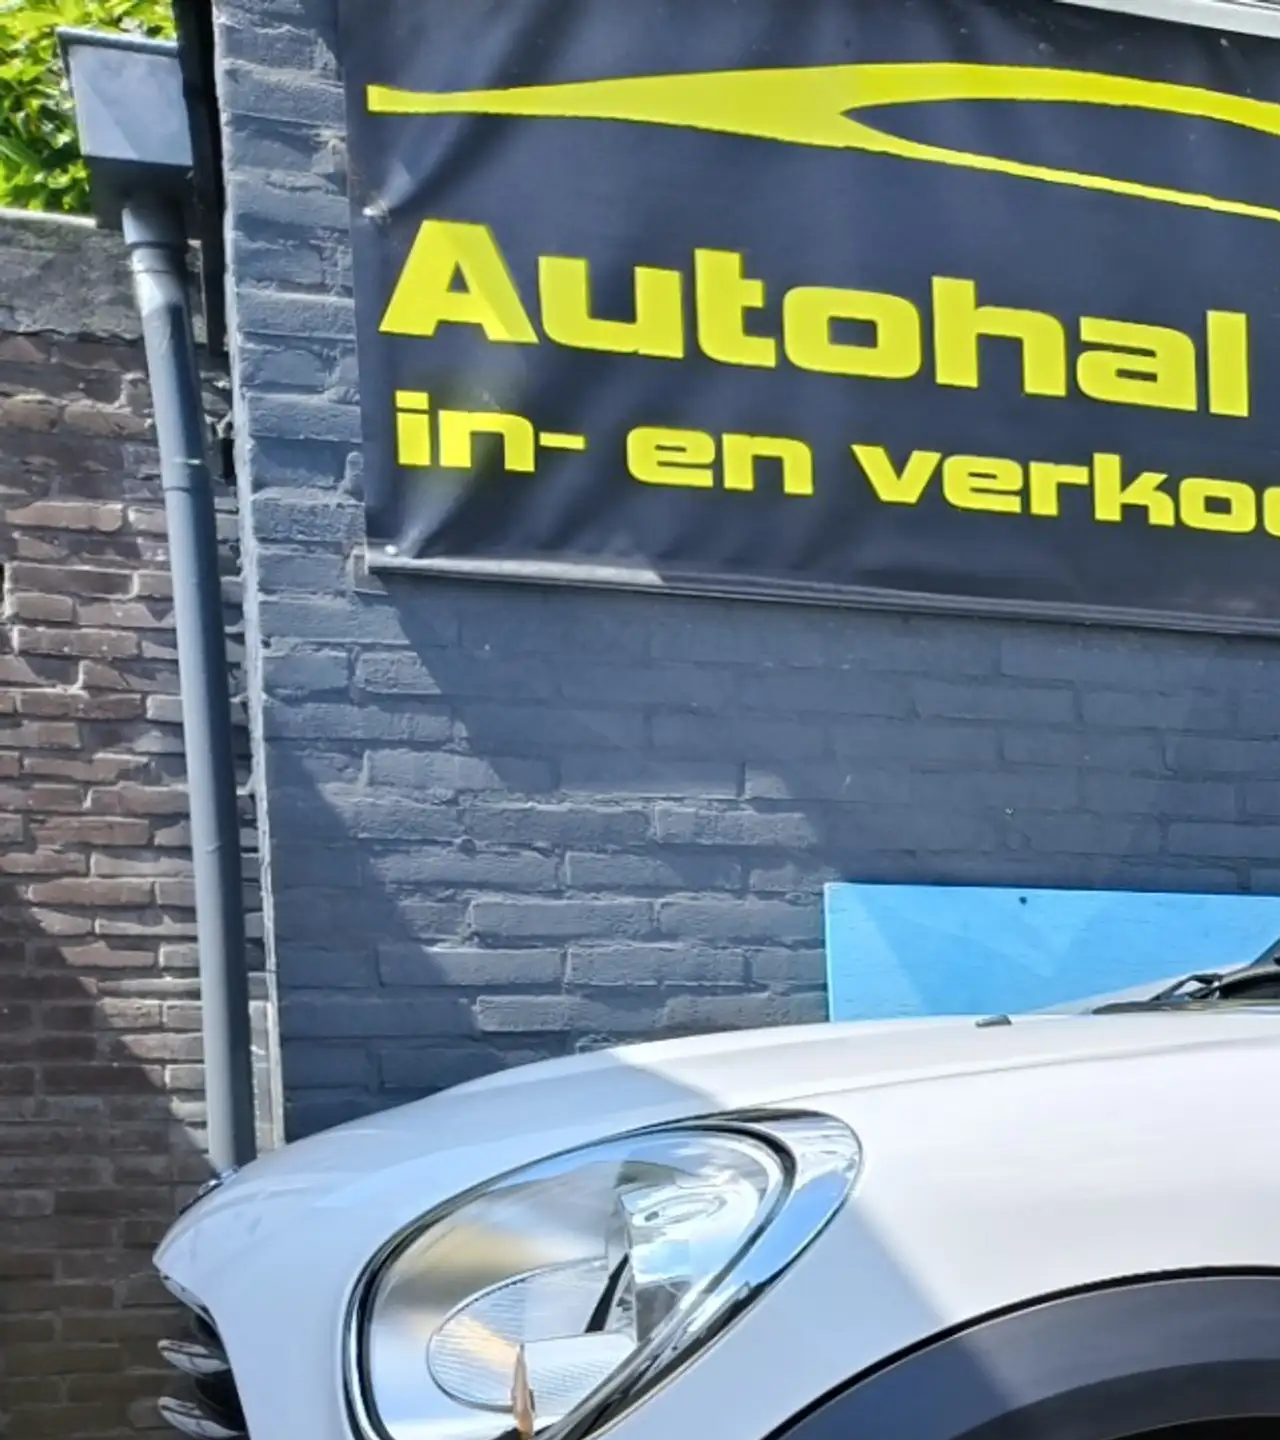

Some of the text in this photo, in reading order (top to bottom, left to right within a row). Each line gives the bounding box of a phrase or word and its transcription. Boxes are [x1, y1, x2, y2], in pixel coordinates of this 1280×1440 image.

[378, 217, 1250, 418] Autohal
[394, 389, 588, 473] in-
[626, 425, 815, 496] en
